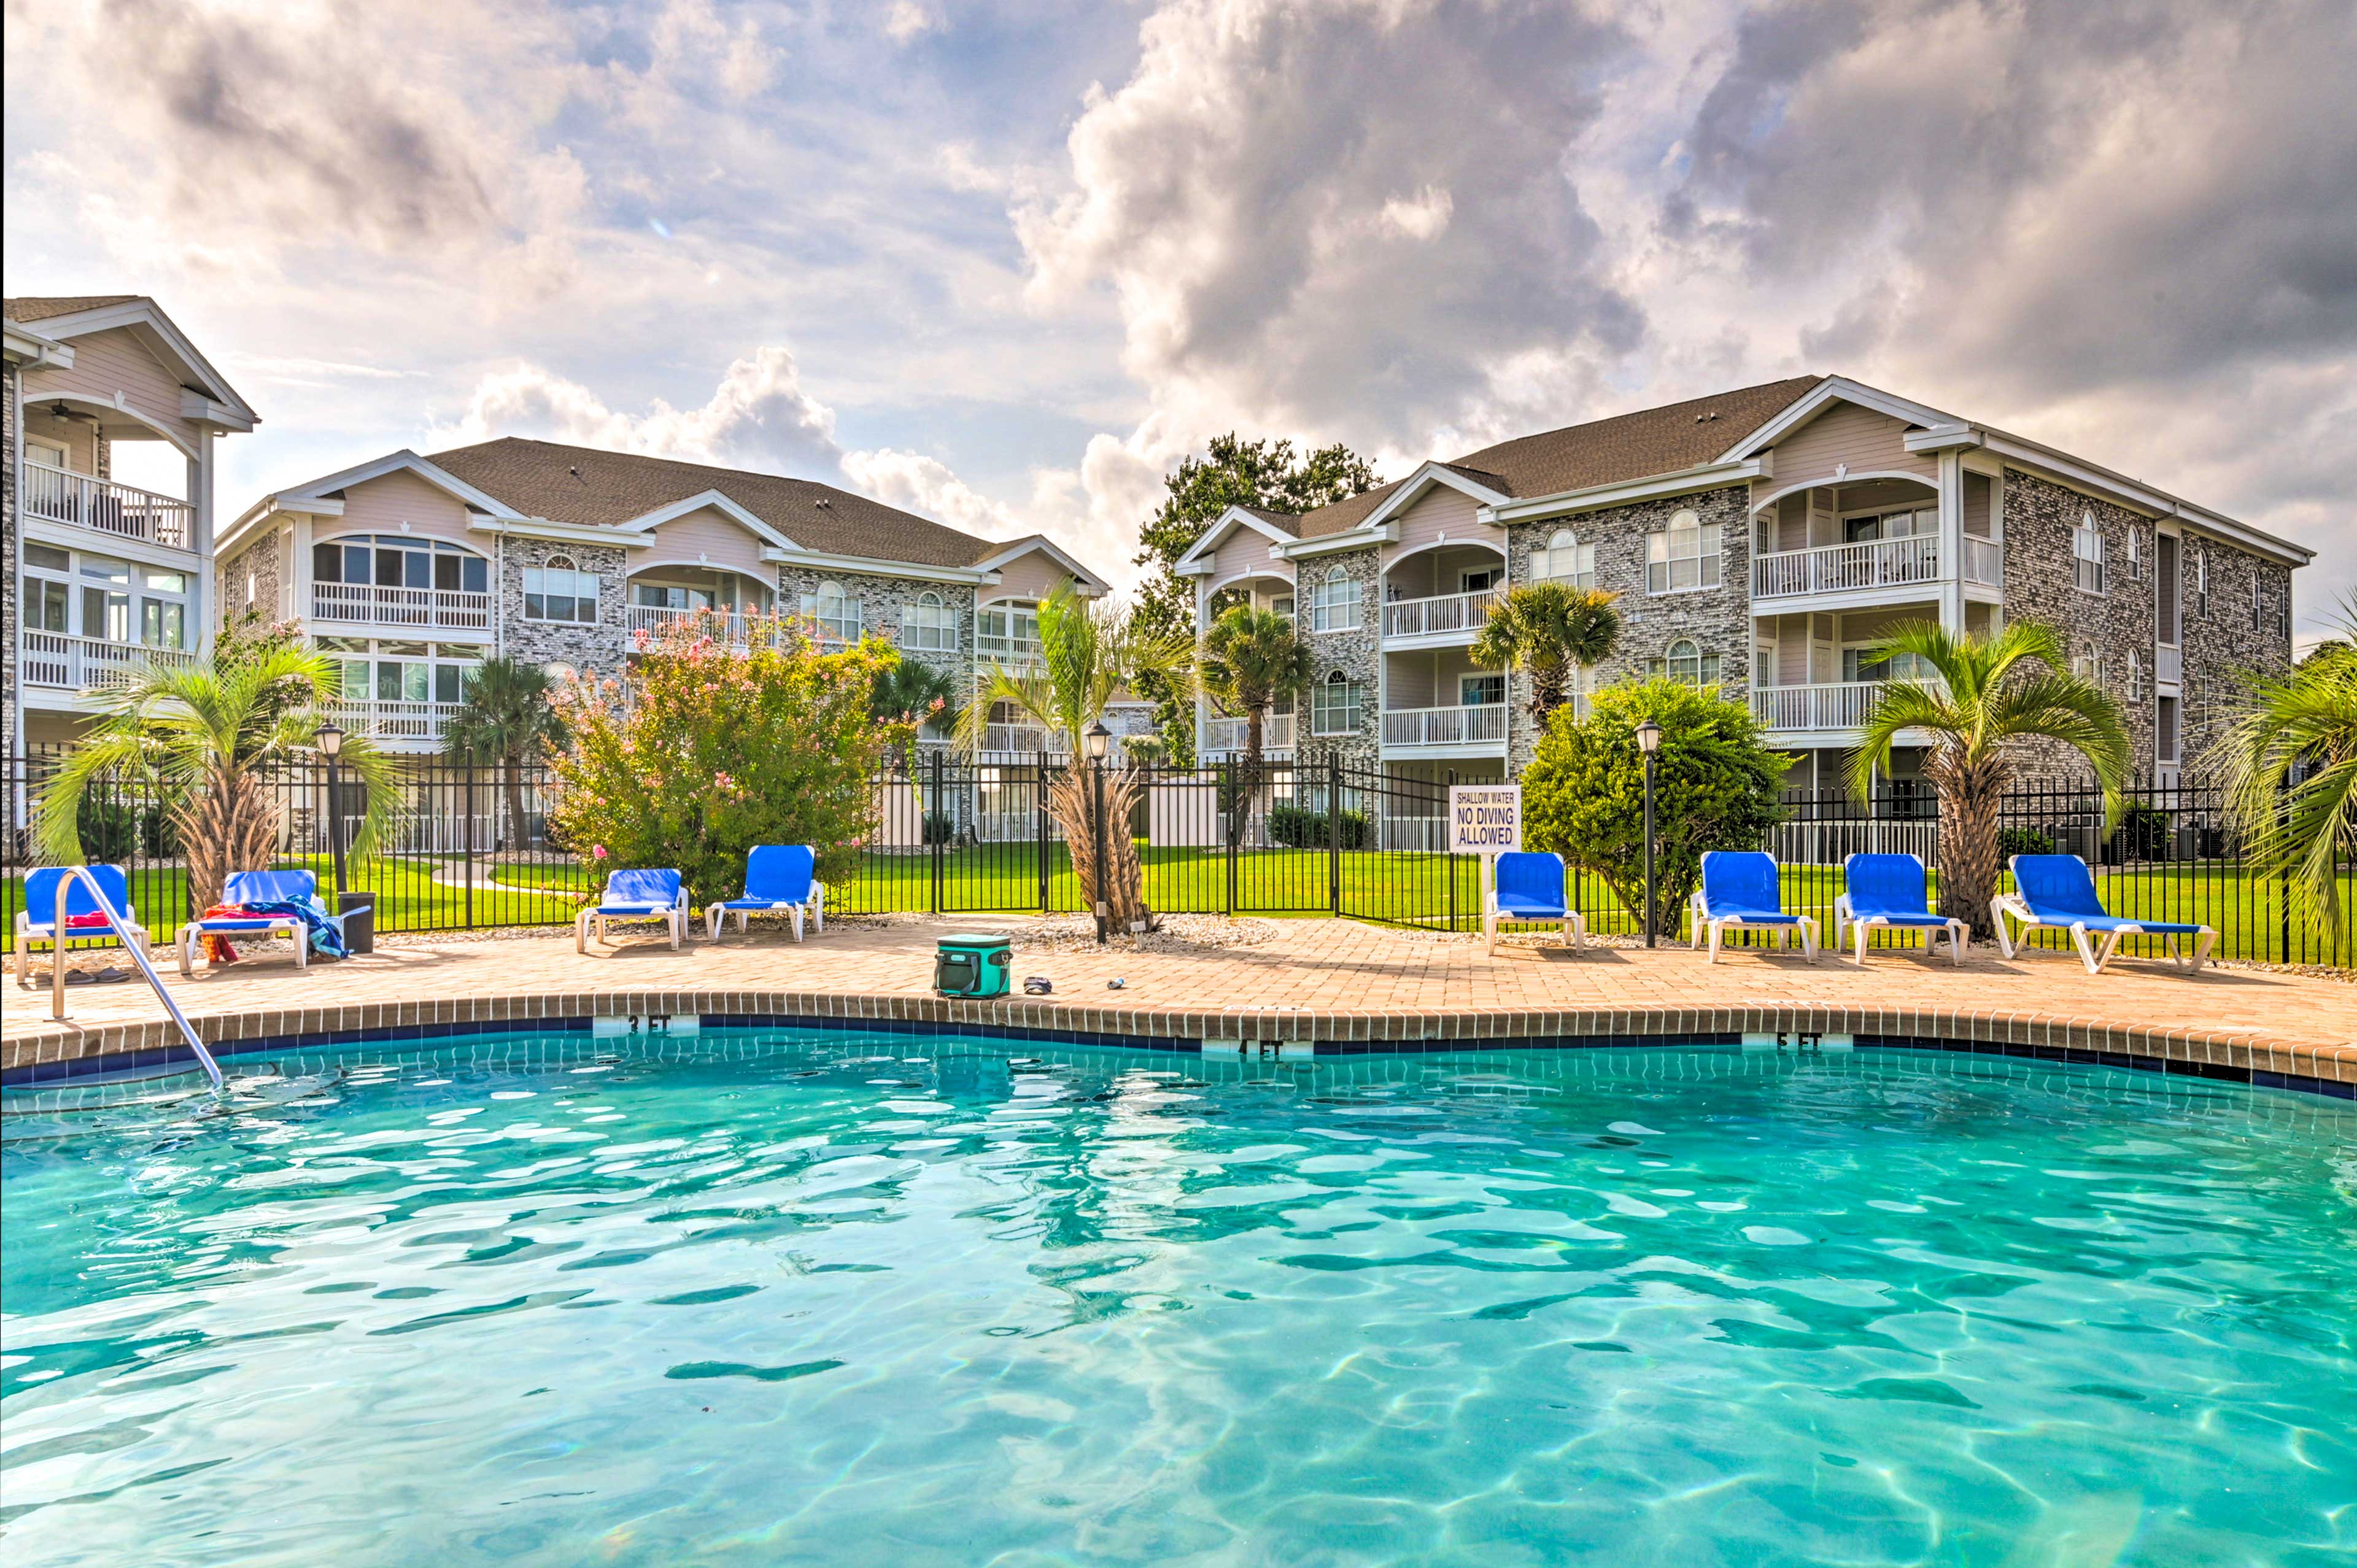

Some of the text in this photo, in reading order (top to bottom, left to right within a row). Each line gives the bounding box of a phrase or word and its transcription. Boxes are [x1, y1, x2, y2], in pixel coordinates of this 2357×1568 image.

[1457, 792, 1514, 804] SHALLOW WATER
[1458, 807, 1514, 825] NO DIVING
[1459, 827, 1512, 844] ALLOWED
